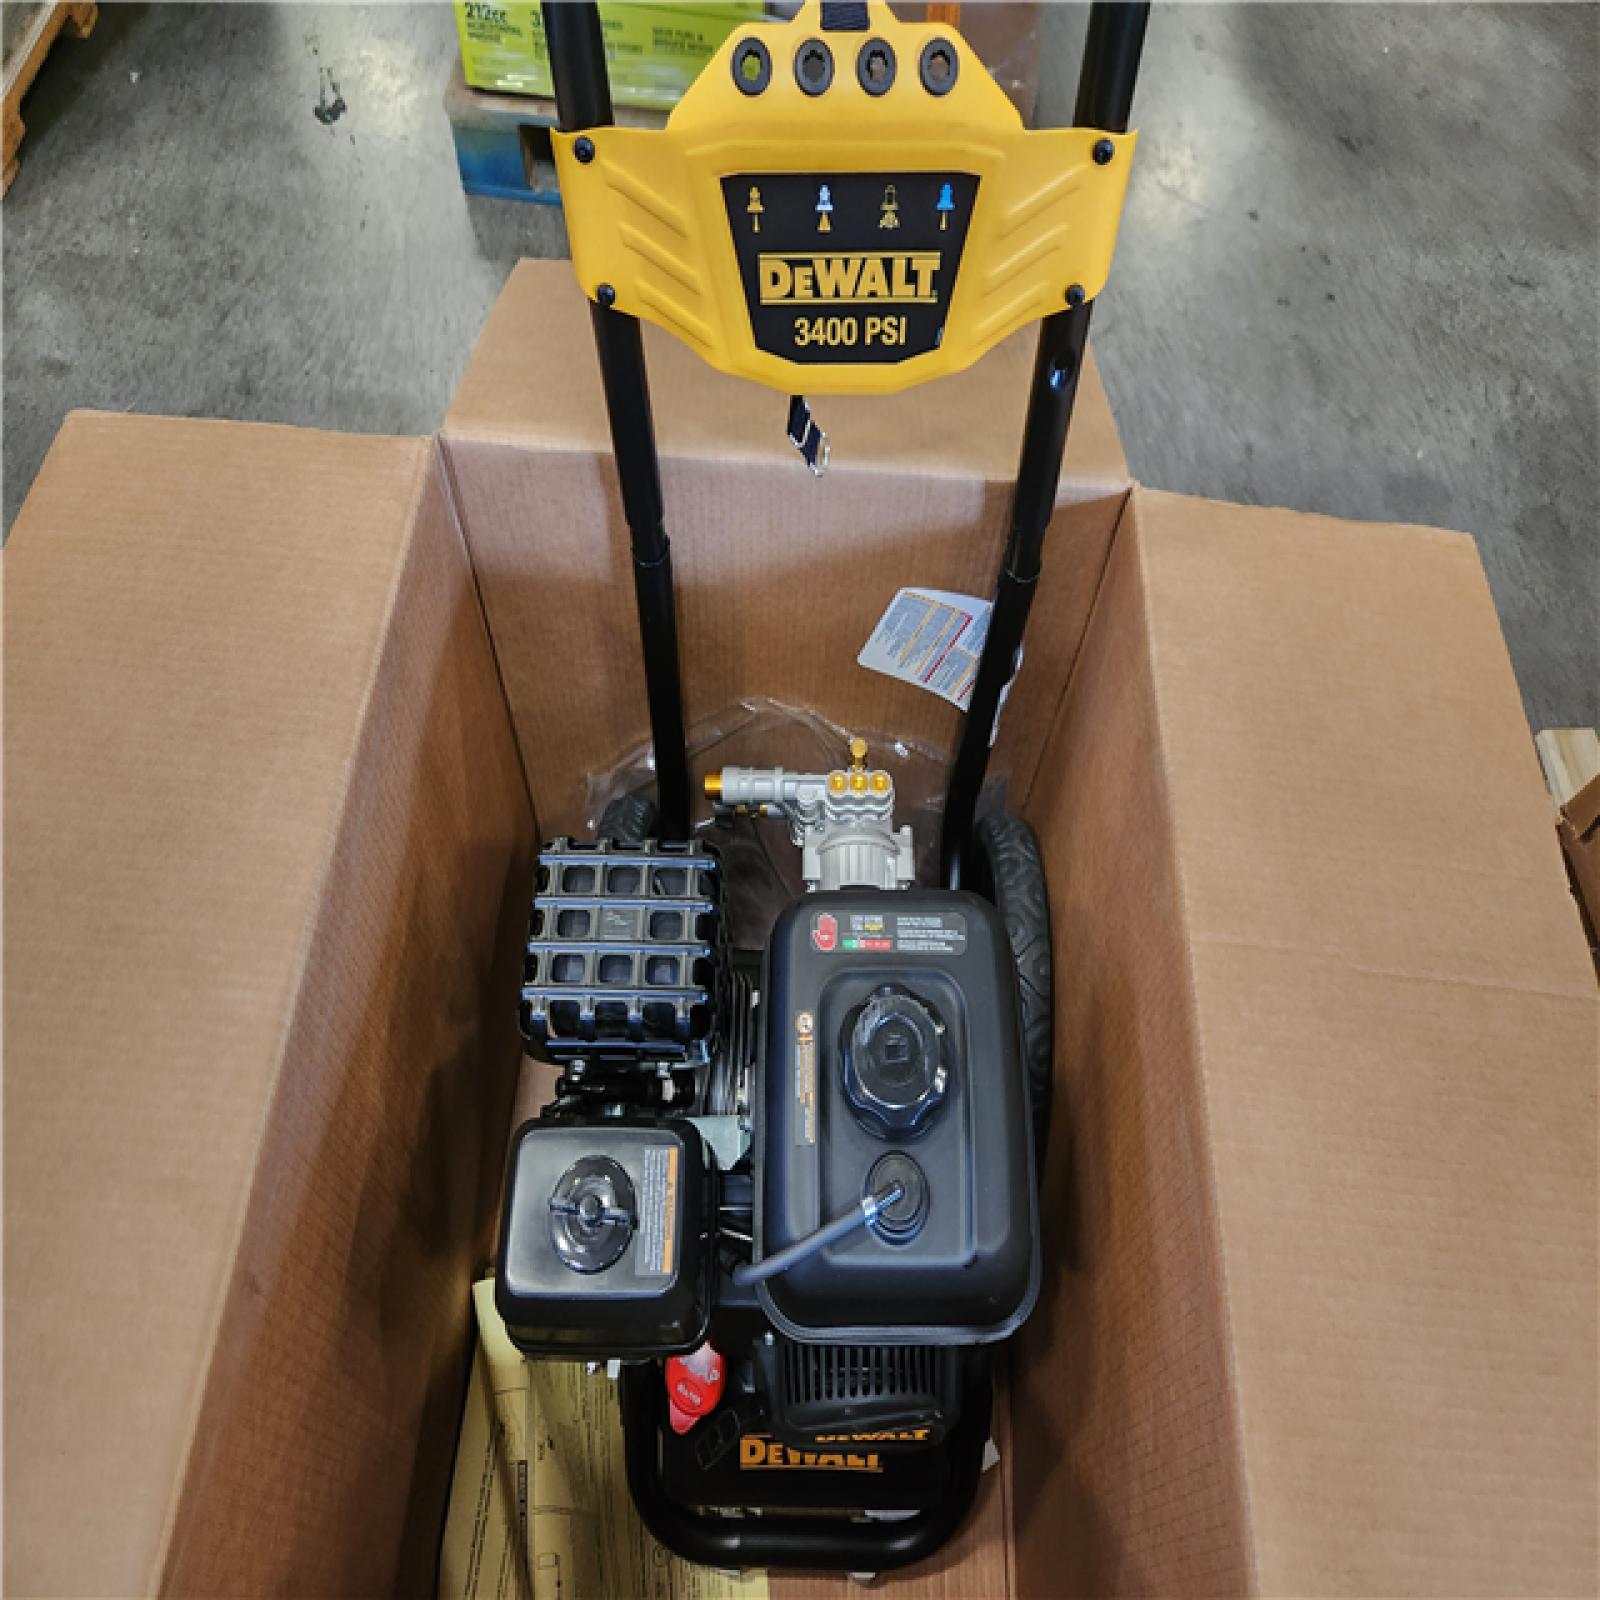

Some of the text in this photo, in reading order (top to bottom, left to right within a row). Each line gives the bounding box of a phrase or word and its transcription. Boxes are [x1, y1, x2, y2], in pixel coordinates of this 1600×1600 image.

[759, 254, 941, 302] DEWALT
[794, 315, 907, 346] 3400 PSI
